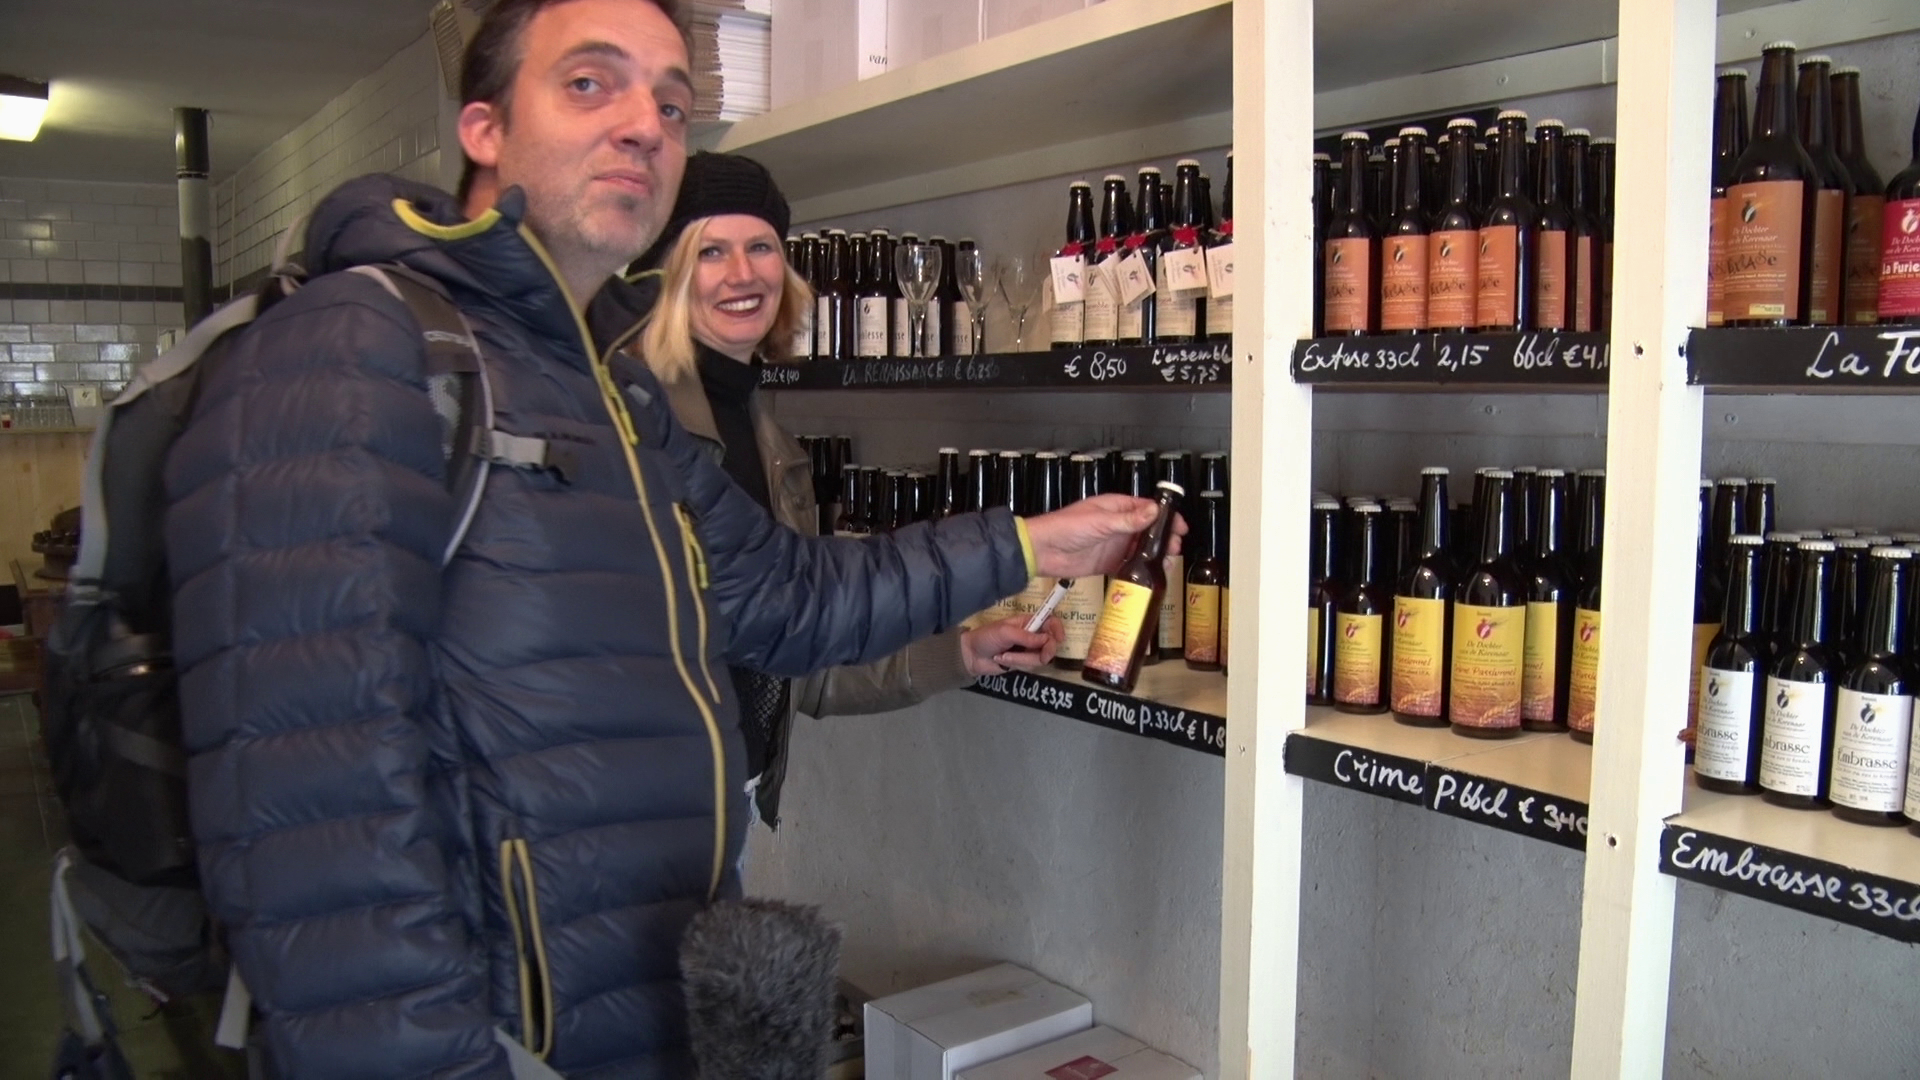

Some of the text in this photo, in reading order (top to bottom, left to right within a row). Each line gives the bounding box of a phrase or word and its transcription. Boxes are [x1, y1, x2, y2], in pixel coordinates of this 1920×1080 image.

[868, 54, 888, 65] van
[1064, 351, 1127, 381] € 8,50
[1301, 343, 1369, 371] Extase
[1375, 343, 1420, 370] 33cl
[1437, 345, 1490, 372] 2,15
[1806, 331, 1870, 378] La
[1180, 363, 1221, 385] 5,75
[1086, 691, 1136, 726] Crime
[1334, 750, 1424, 795] Crime
[1518, 796, 1534, 824] €
[1671, 831, 1842, 904] Embrasse
